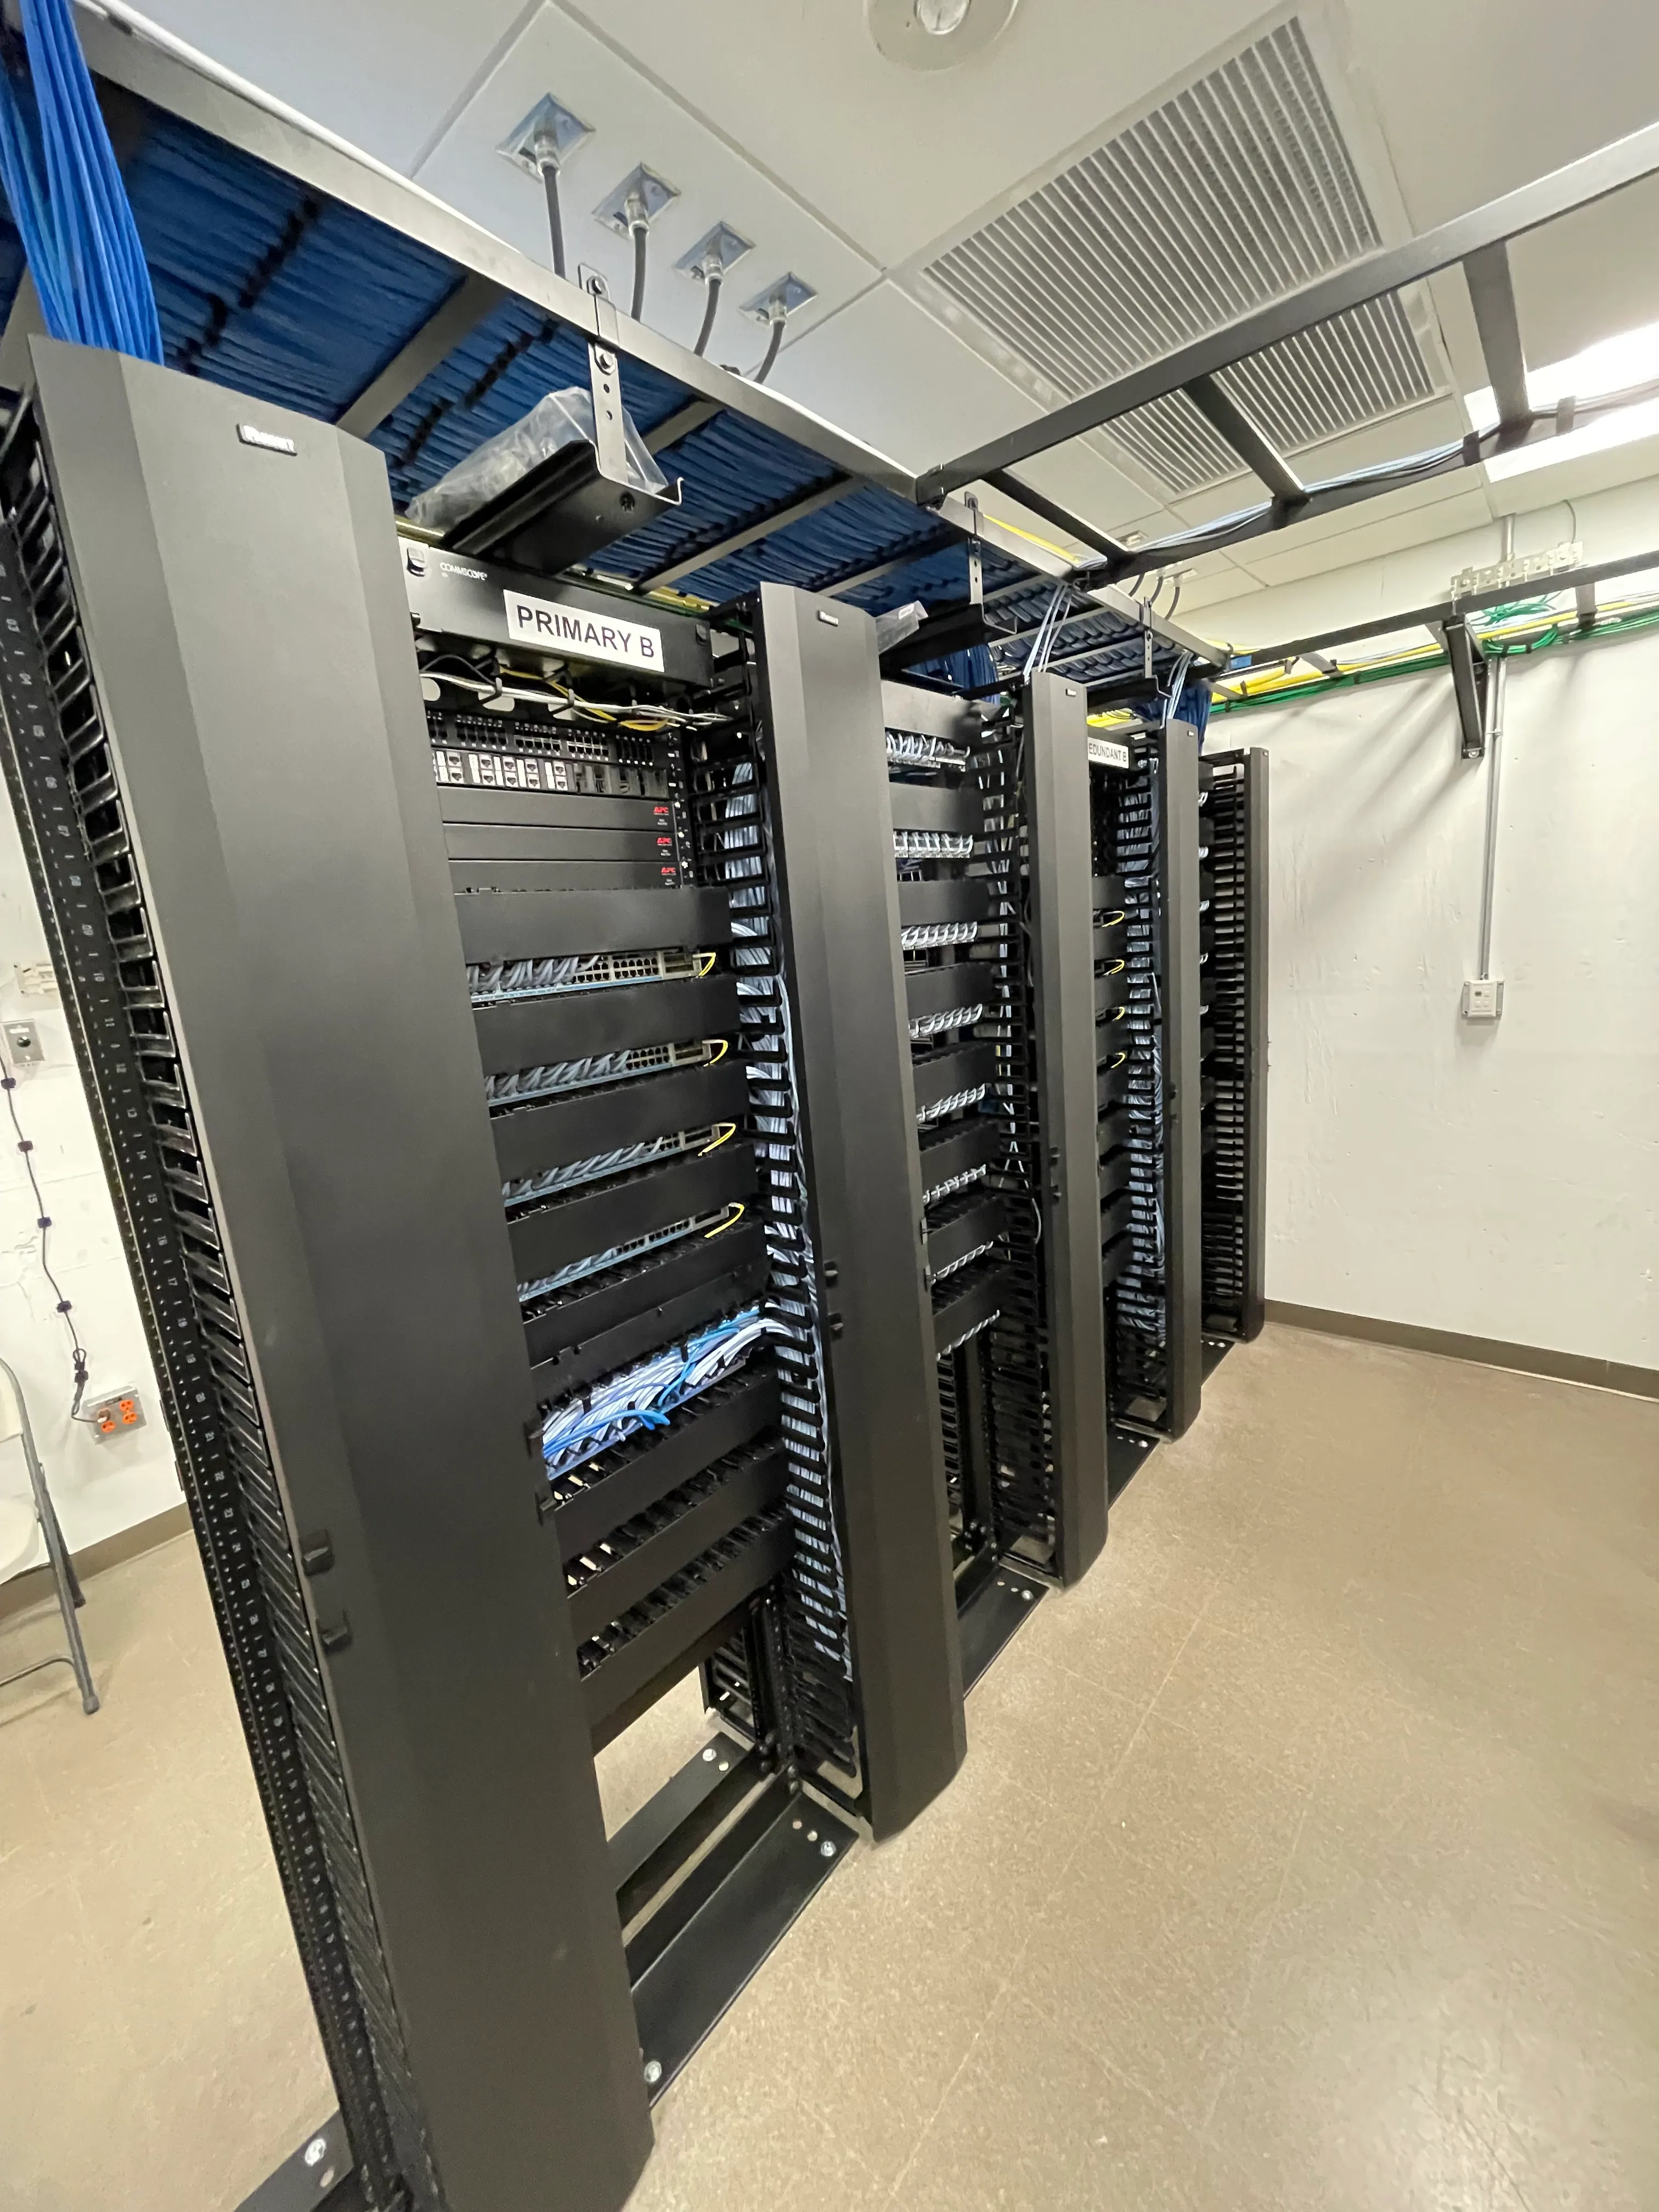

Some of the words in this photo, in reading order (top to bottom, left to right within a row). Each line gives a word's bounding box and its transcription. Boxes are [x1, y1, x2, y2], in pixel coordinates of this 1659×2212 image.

[517, 605, 632, 652] PRIMARY
[640, 636, 654, 658] B
[1088, 743, 1121, 761] EDUNDANT
